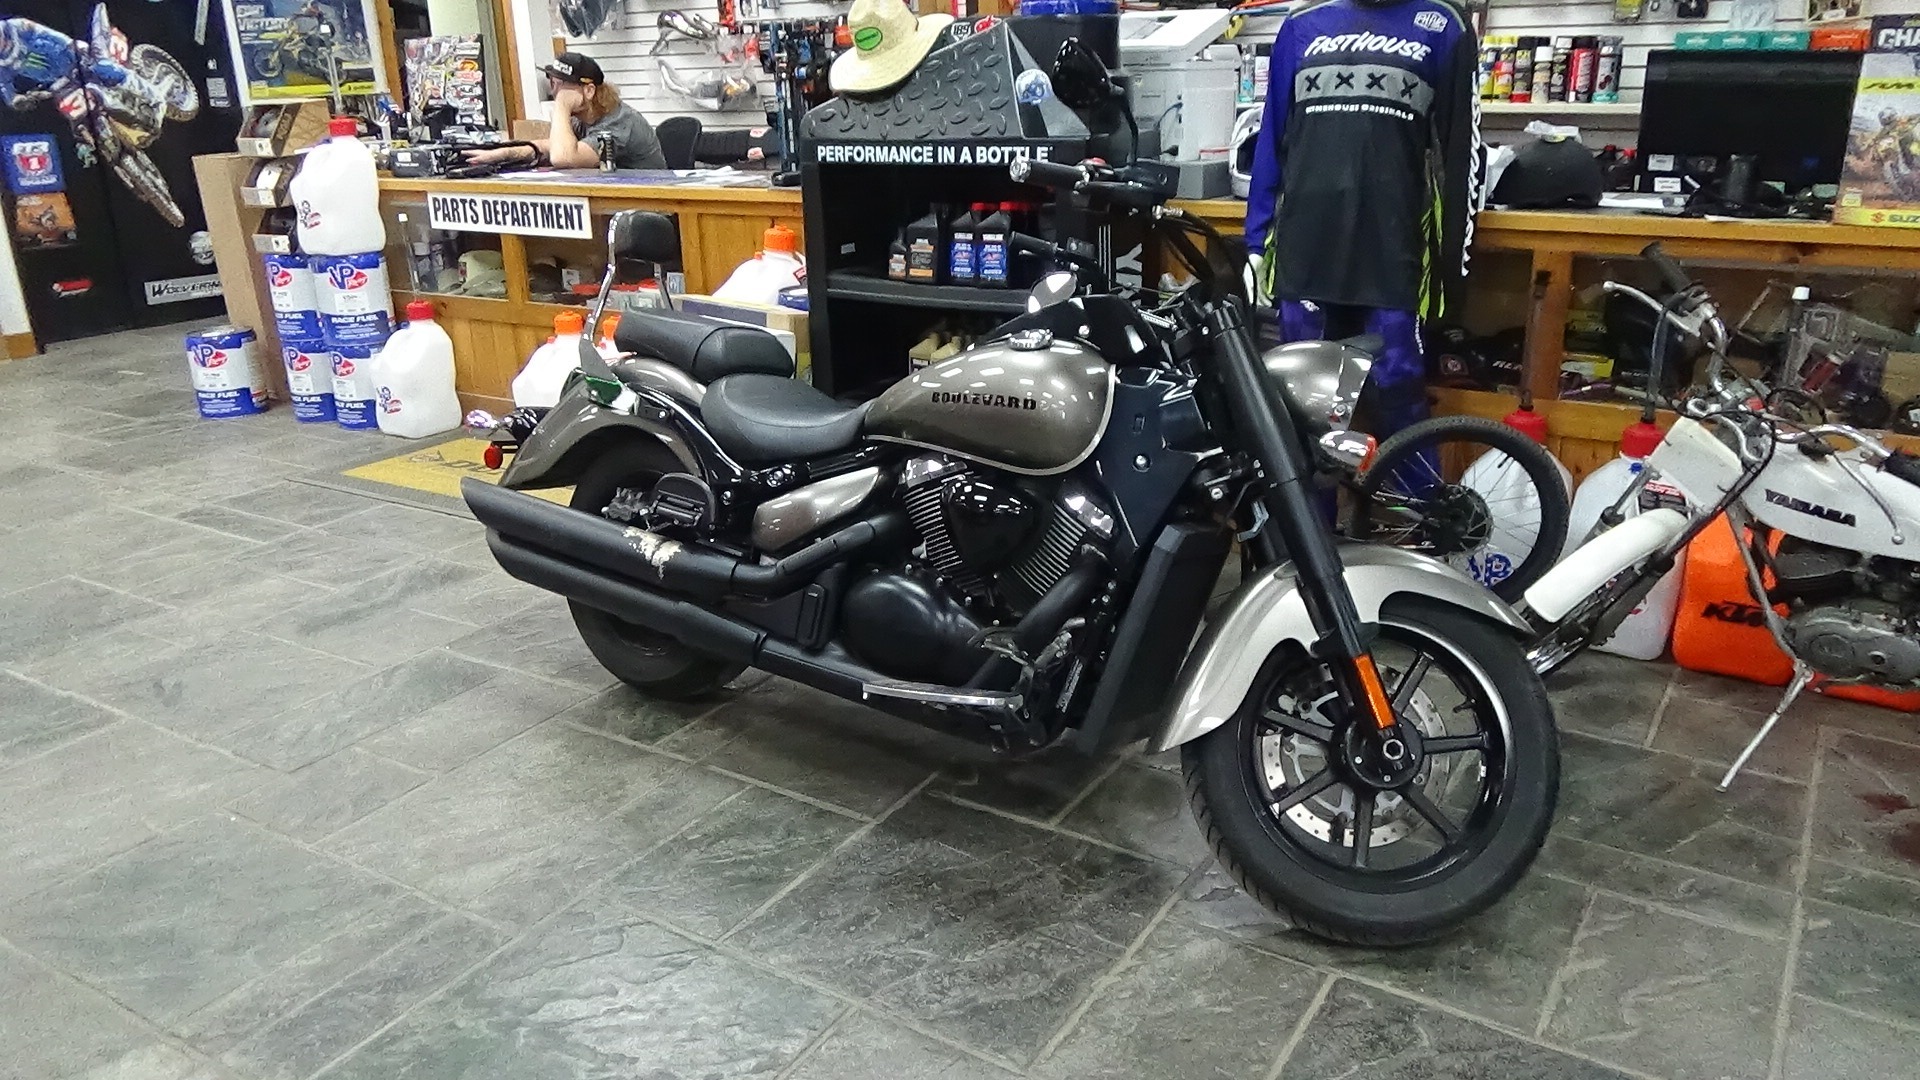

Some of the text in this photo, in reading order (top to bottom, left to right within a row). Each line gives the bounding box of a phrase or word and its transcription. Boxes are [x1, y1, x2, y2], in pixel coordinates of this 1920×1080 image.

[1304, 31, 1432, 61] FASTHOUSE
[817, 145, 934, 163] PERFORMANCE
[937, 145, 955, 163] IN
[959, 146, 973, 163] A
[432, 196, 584, 231] PARTS DEPARTMENT
[328, 263, 355, 290] VP
[356, 313, 380, 323] FUEL
[191, 344, 214, 368] VP
[931, 391, 1037, 410] BOULEVARD
[1764, 488, 1857, 528] YAMAHA
